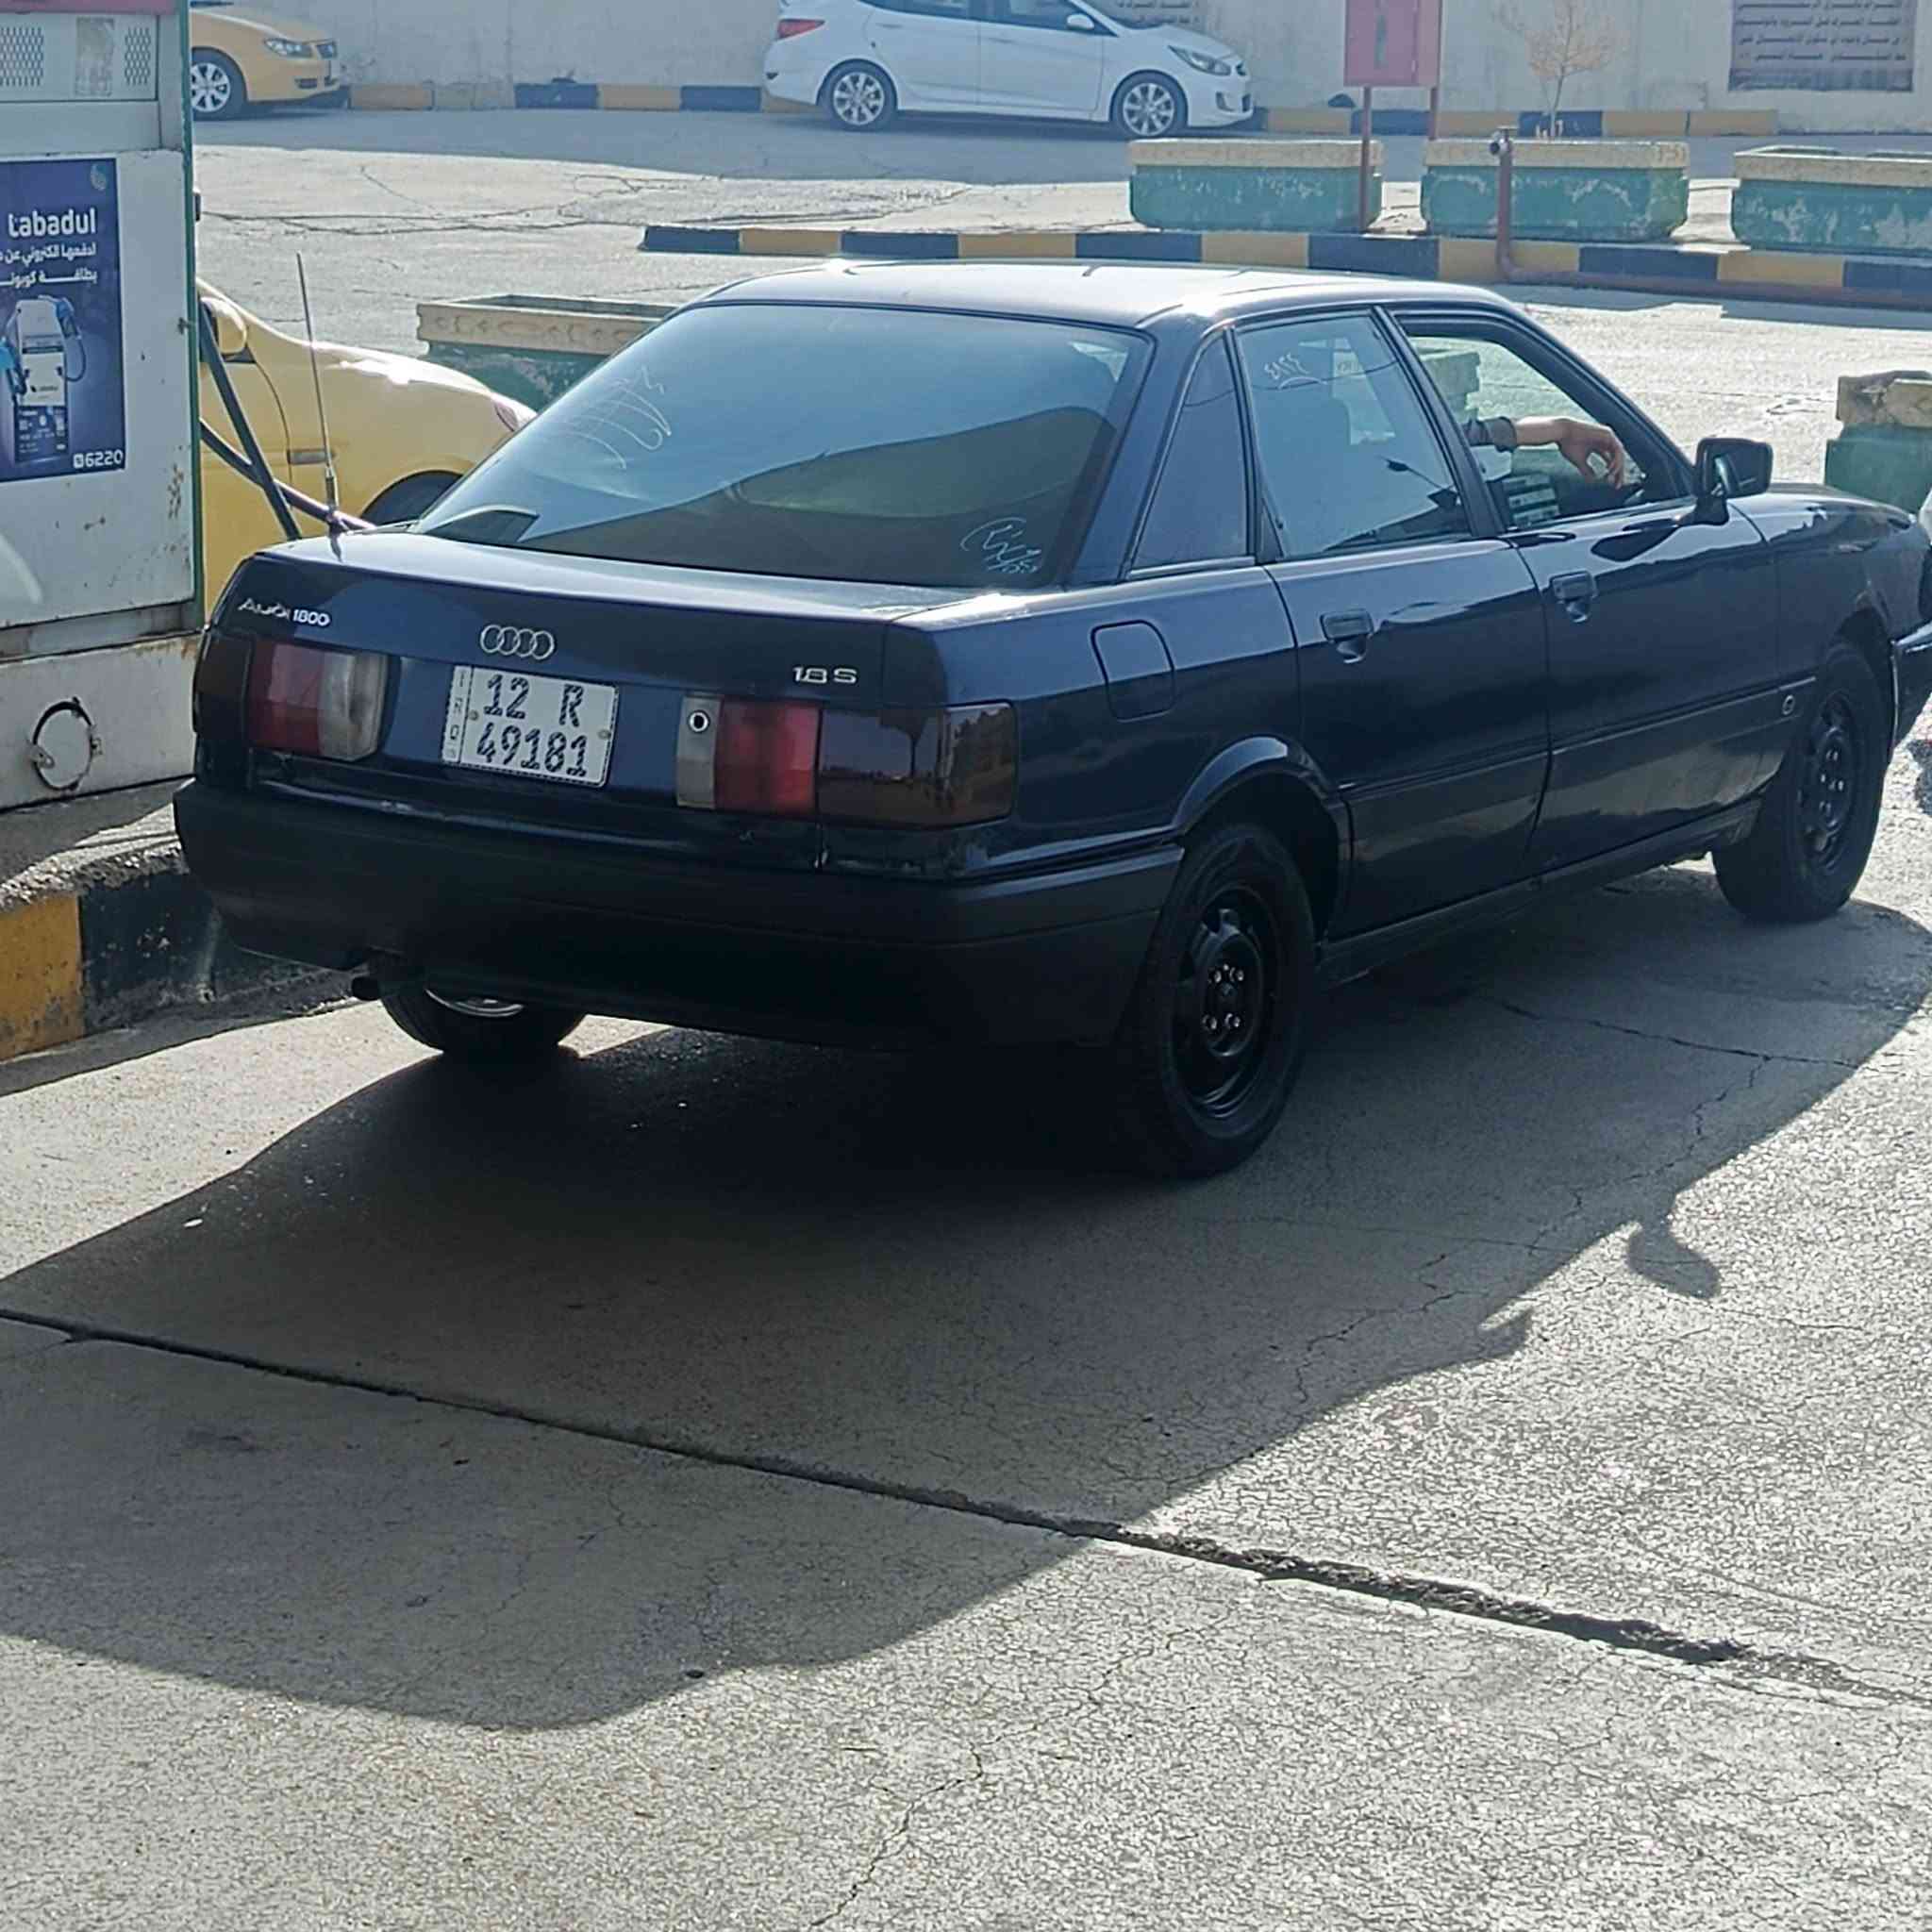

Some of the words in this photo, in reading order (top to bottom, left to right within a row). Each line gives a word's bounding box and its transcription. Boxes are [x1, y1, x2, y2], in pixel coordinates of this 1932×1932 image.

[8, 207, 96, 238] tabadul
[85, 449, 124, 468] 6220
[292, 608, 331, 626] 1800
[833, 668, 858, 684] S
[484, 674, 530, 720] 12
[558, 683, 585, 728] R
[475, 722, 588, 777] 49181
